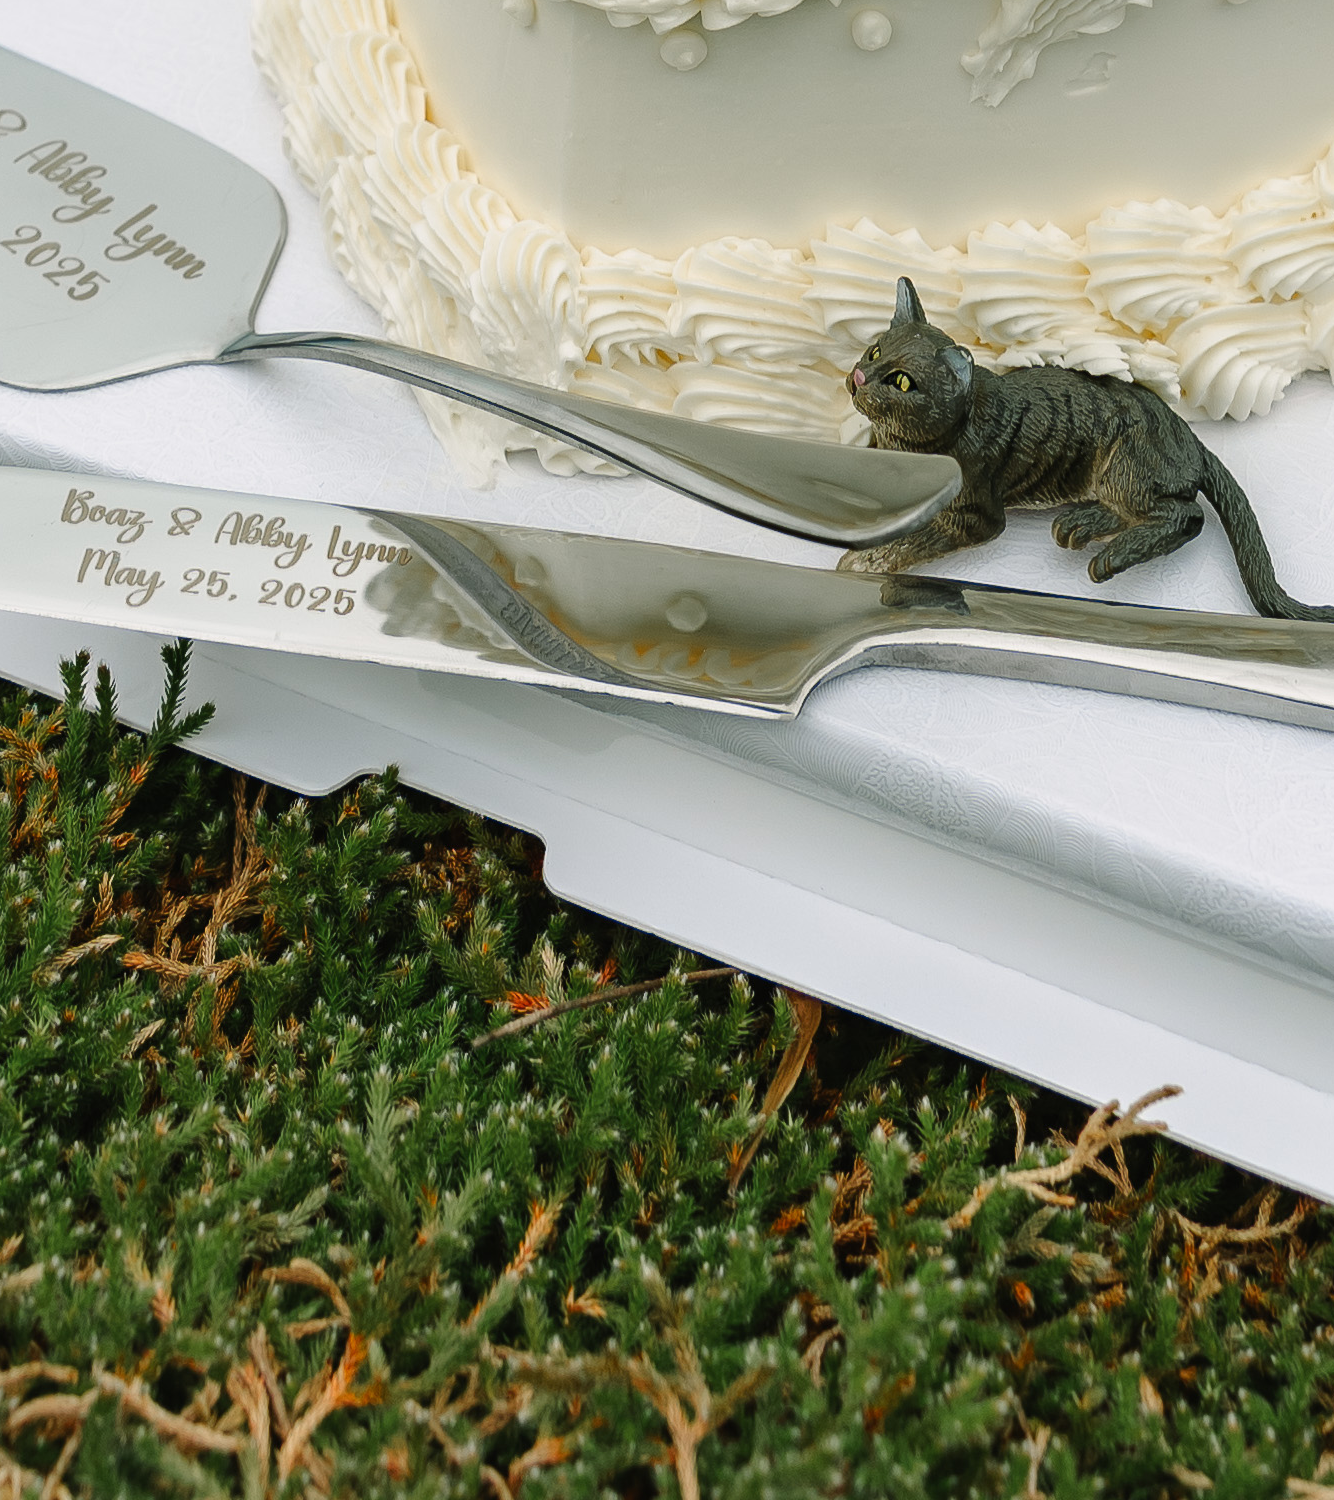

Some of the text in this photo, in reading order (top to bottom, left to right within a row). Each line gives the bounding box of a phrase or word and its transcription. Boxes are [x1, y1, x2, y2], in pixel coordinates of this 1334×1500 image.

[13, 139, 115, 224] Abby
[103, 203, 206, 281] Lynn
[0, 225, 111, 302] 2025
[60, 488, 413, 578] Boaz & Abby Lynn
[76, 547, 358, 616] May 25, 2025
